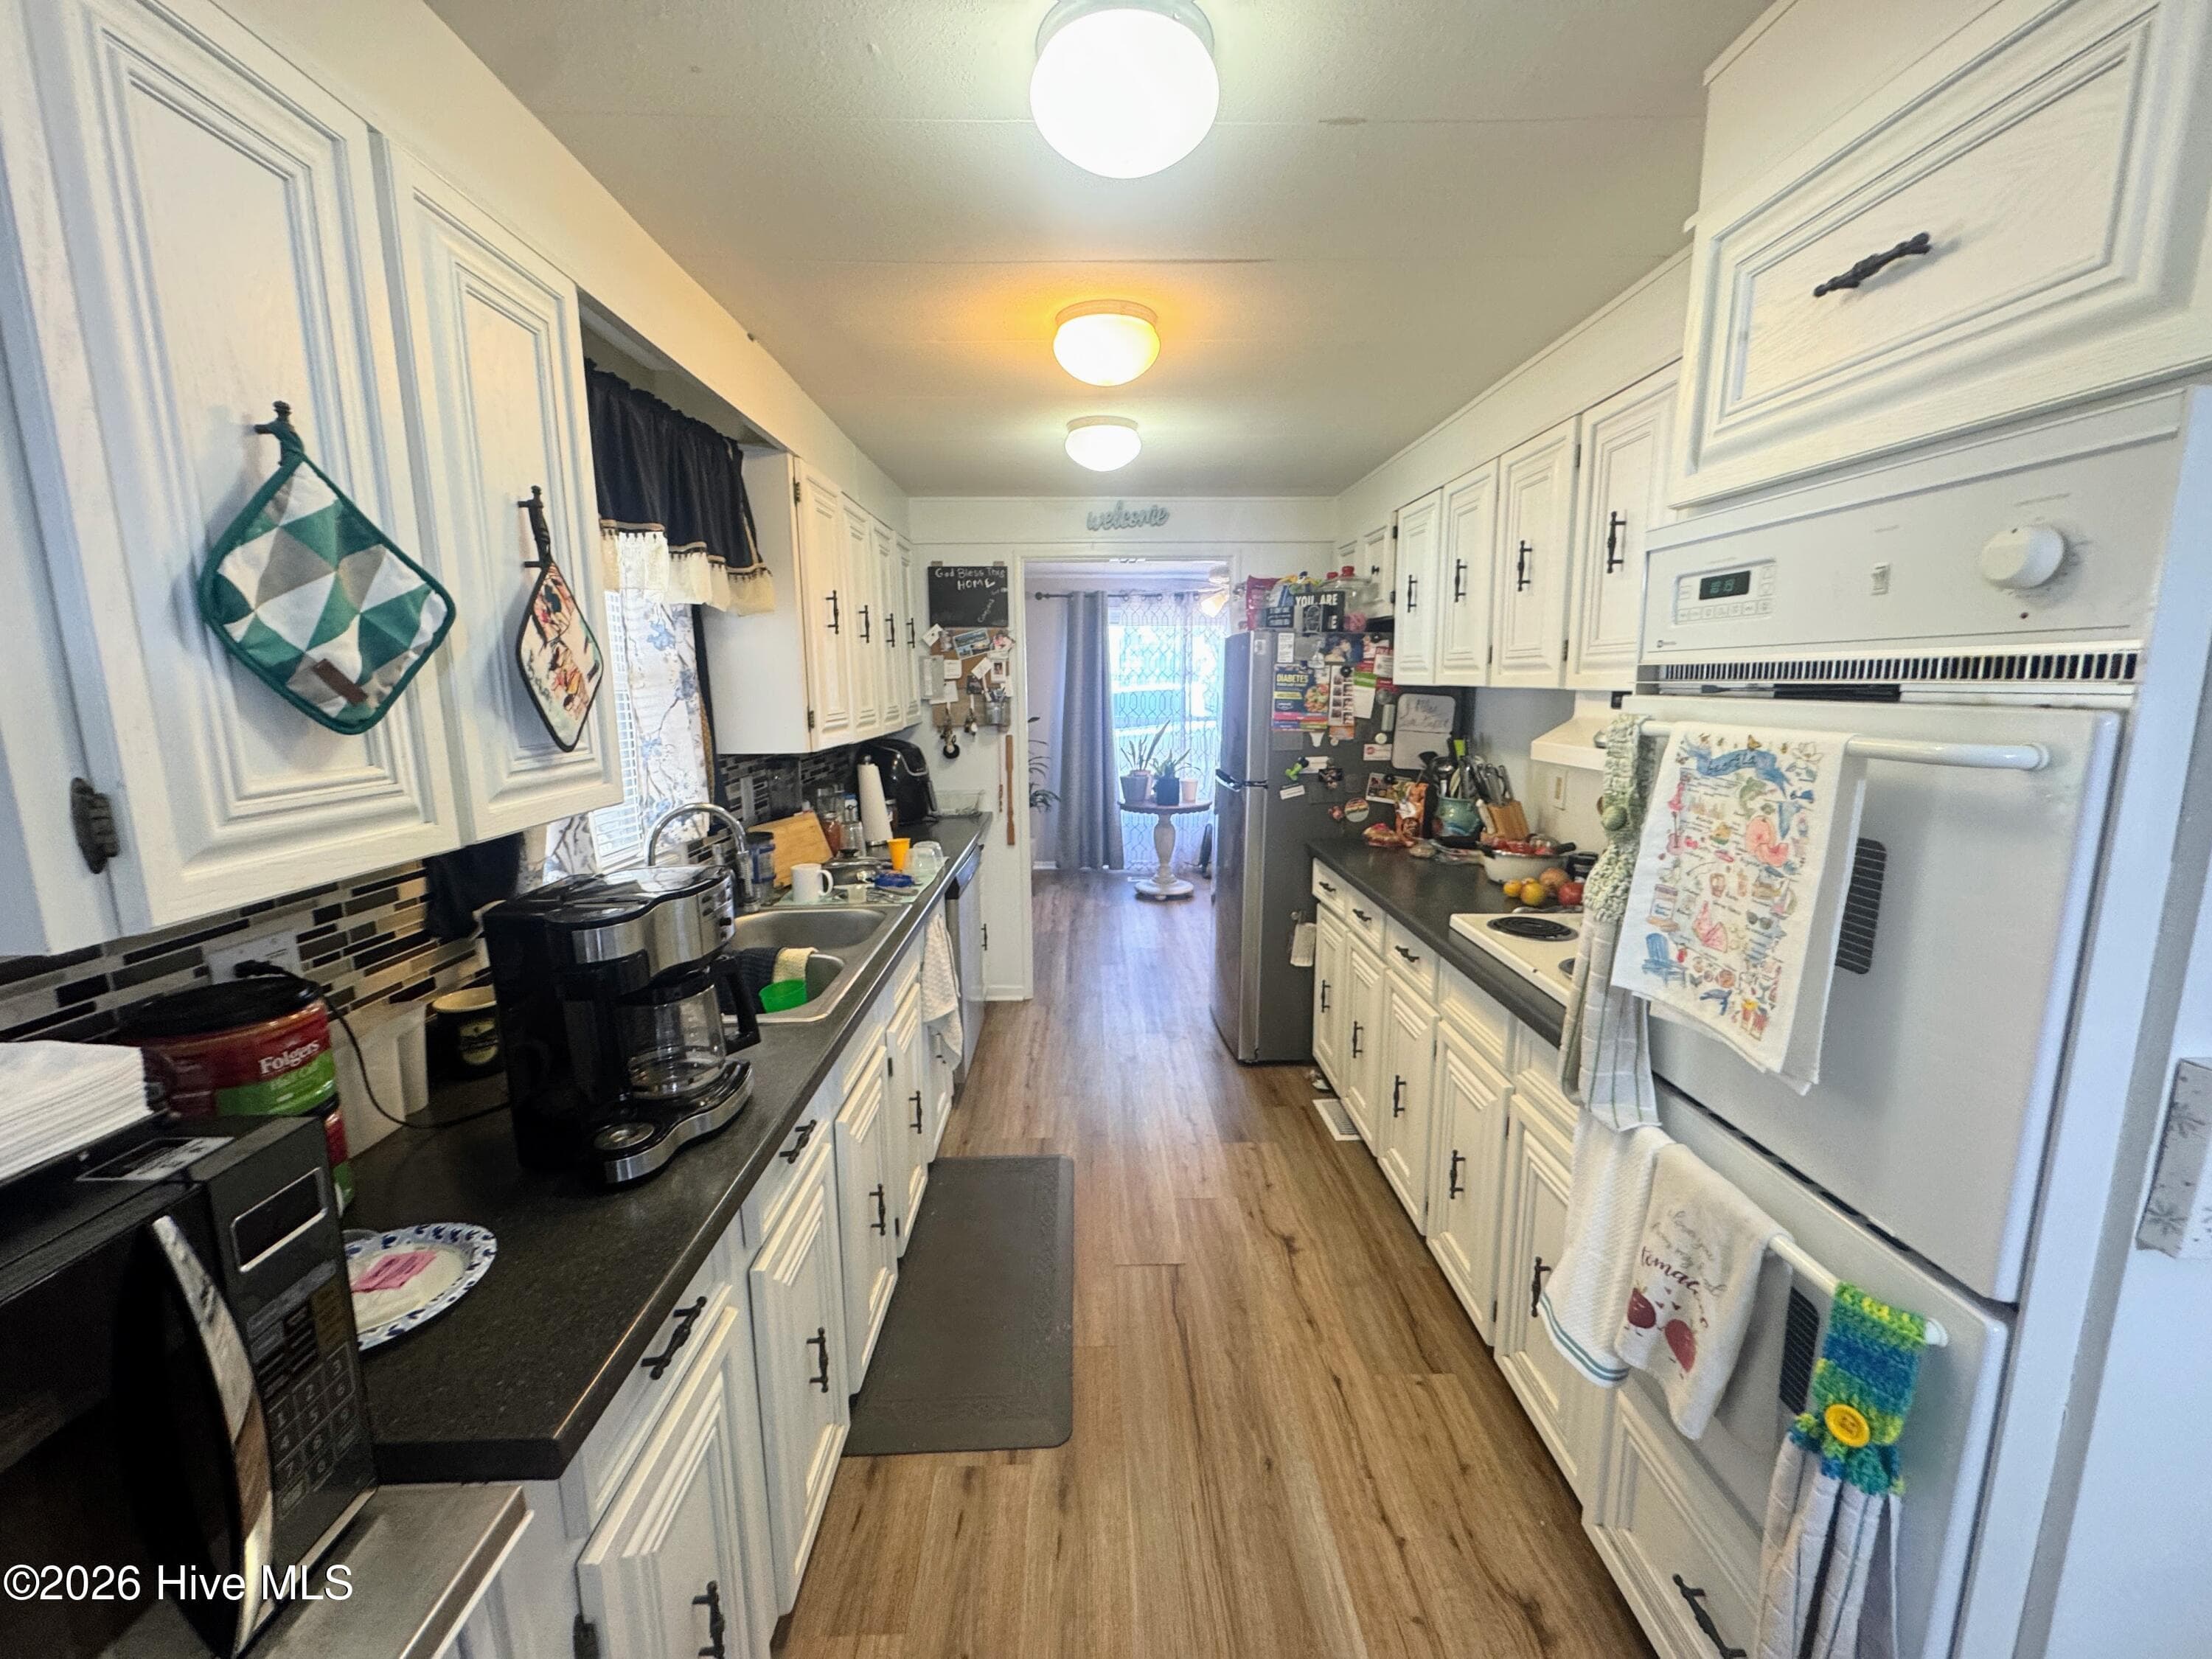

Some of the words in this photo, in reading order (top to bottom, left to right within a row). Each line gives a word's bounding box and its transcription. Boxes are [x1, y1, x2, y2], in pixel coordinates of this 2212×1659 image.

[1087, 500, 1169, 531] welcome
[935, 568, 954, 578] God
[957, 568, 984, 579] Bless
[957, 578, 995, 591] HOME
[1319, 593, 1338, 605] ARE
[1276, 673, 1309, 684] DIABETES
[258, 1040, 319, 1075] Folgers
